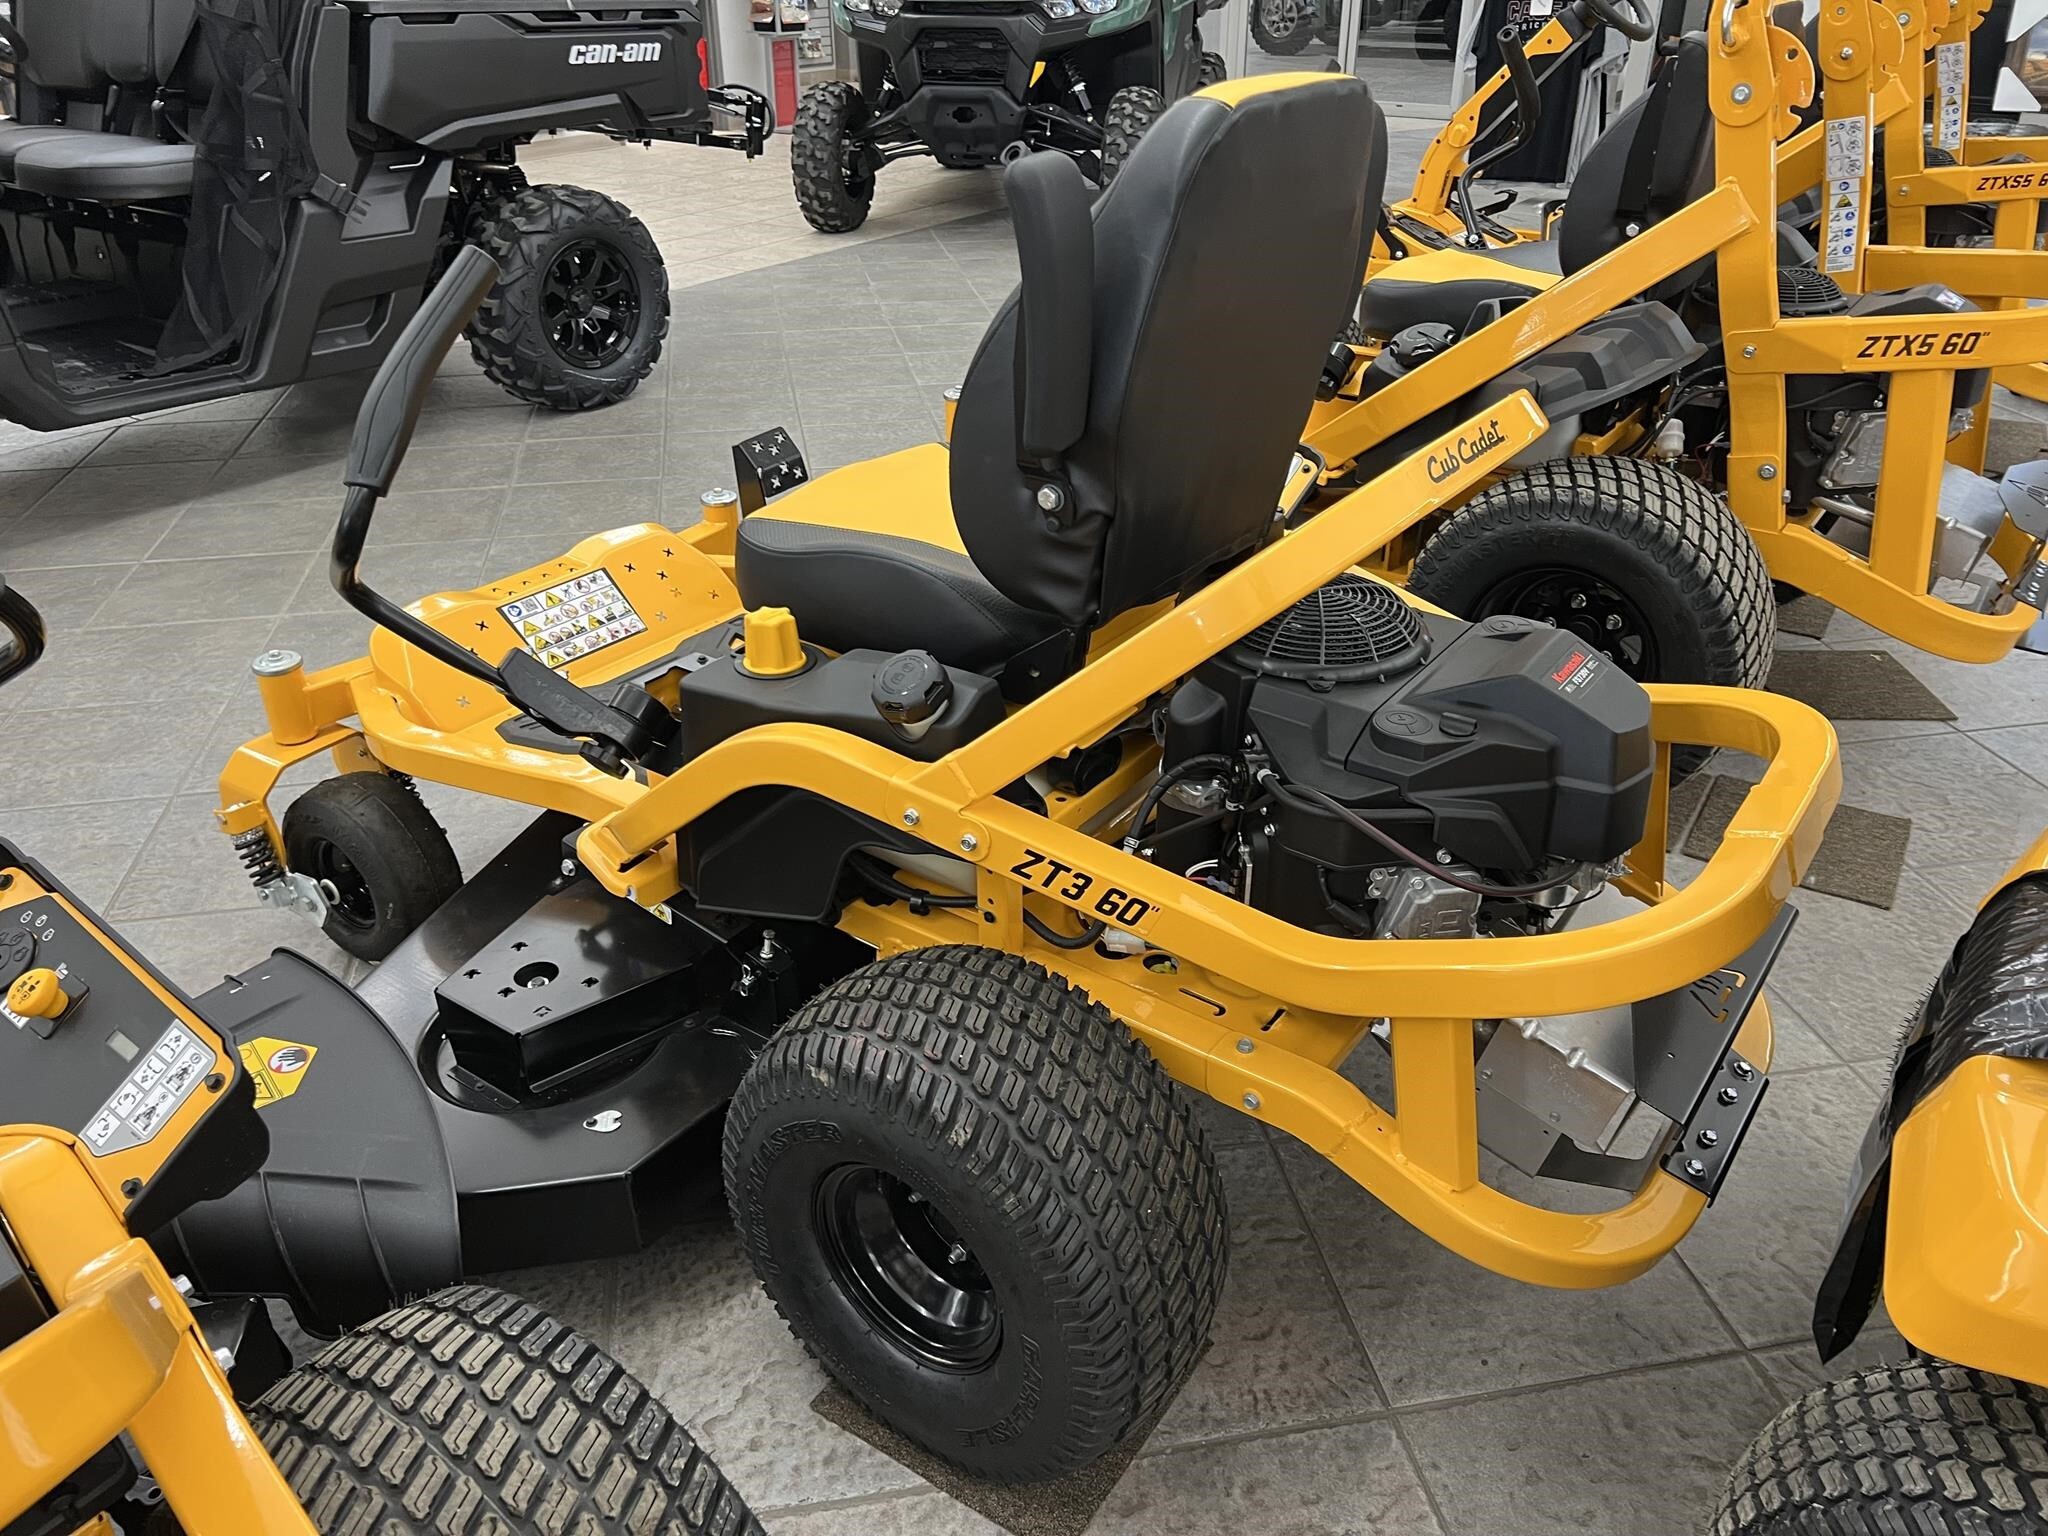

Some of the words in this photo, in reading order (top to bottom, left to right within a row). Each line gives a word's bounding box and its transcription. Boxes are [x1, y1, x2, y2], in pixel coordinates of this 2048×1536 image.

[568, 42, 661, 65] can-am
[1976, 174, 2035, 191] ZTXS5
[1856, 333, 1940, 358] ZTX5
[1427, 446, 1460, 484] Cub
[1457, 419, 1506, 464] Cadet
[1551, 651, 1585, 684] Kawasaki
[1010, 848, 1094, 901] ZT3
